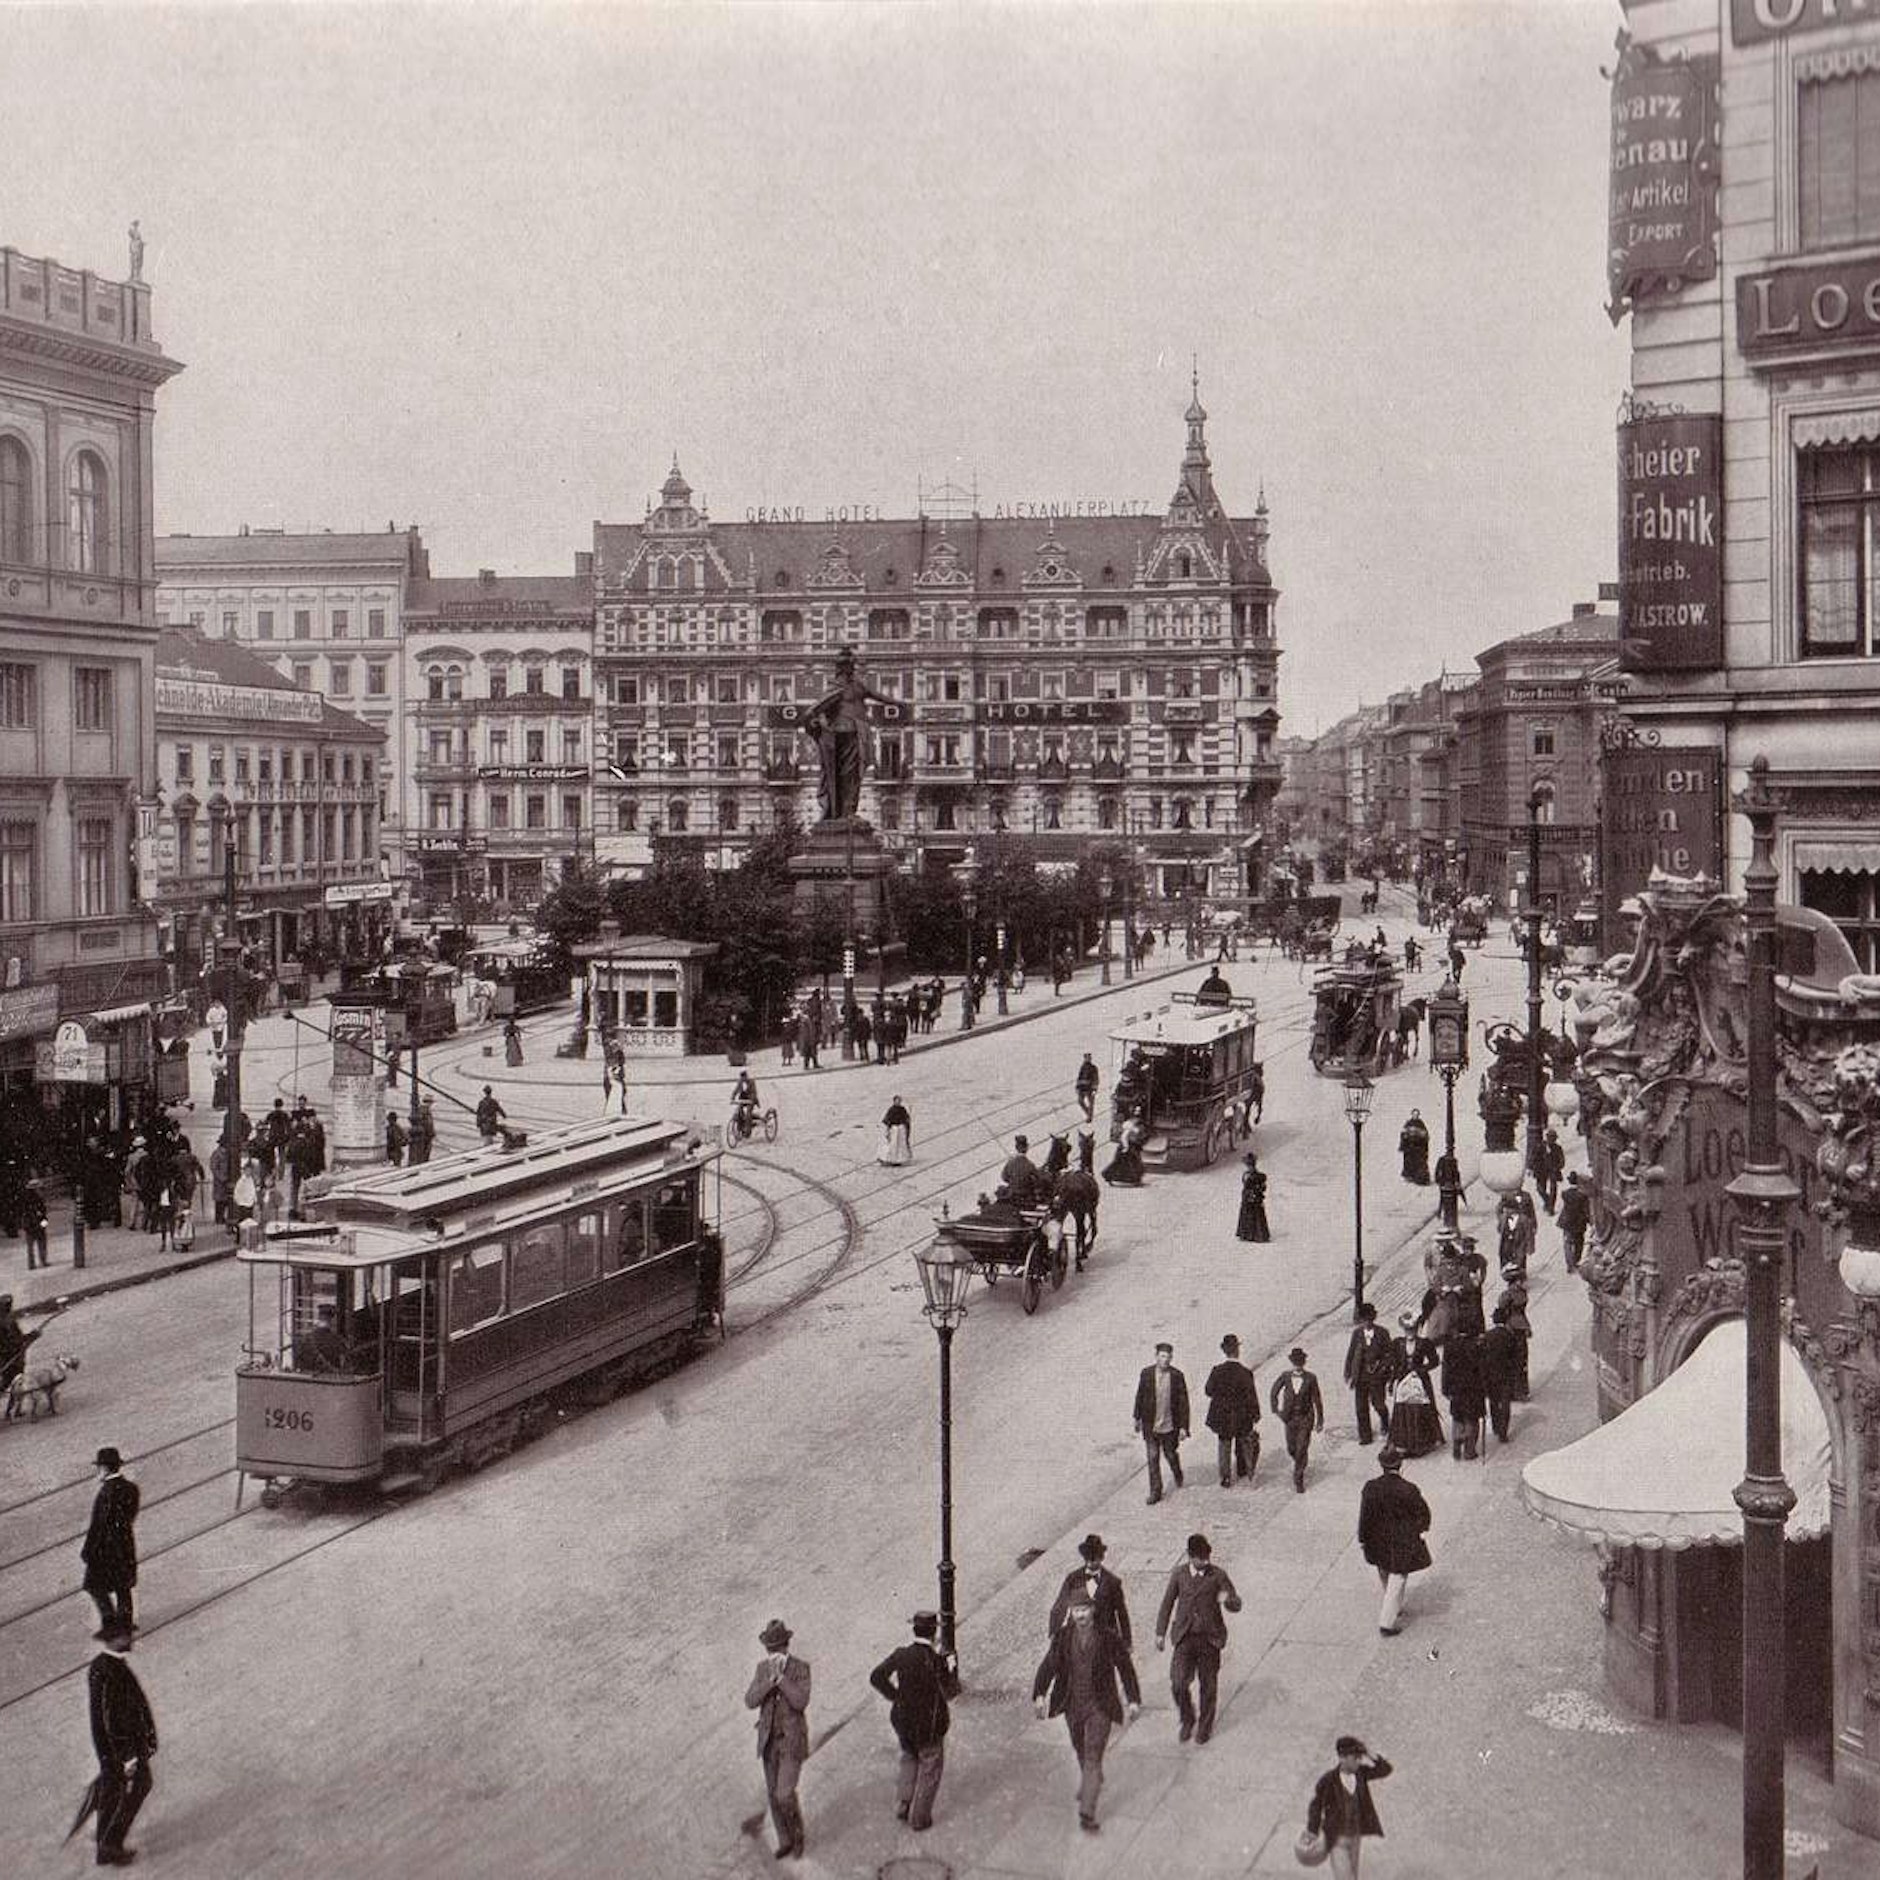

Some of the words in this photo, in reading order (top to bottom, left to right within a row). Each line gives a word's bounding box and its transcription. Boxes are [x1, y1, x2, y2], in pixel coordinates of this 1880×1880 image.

[745, 504, 805, 523] GRAND
[825, 504, 885, 522] HOTEL
[994, 500, 1151, 519] ALEXANDERPLATZ
[1631, 493, 1715, 548] Fabrik
[987, 703, 1103, 718] HOTEL
